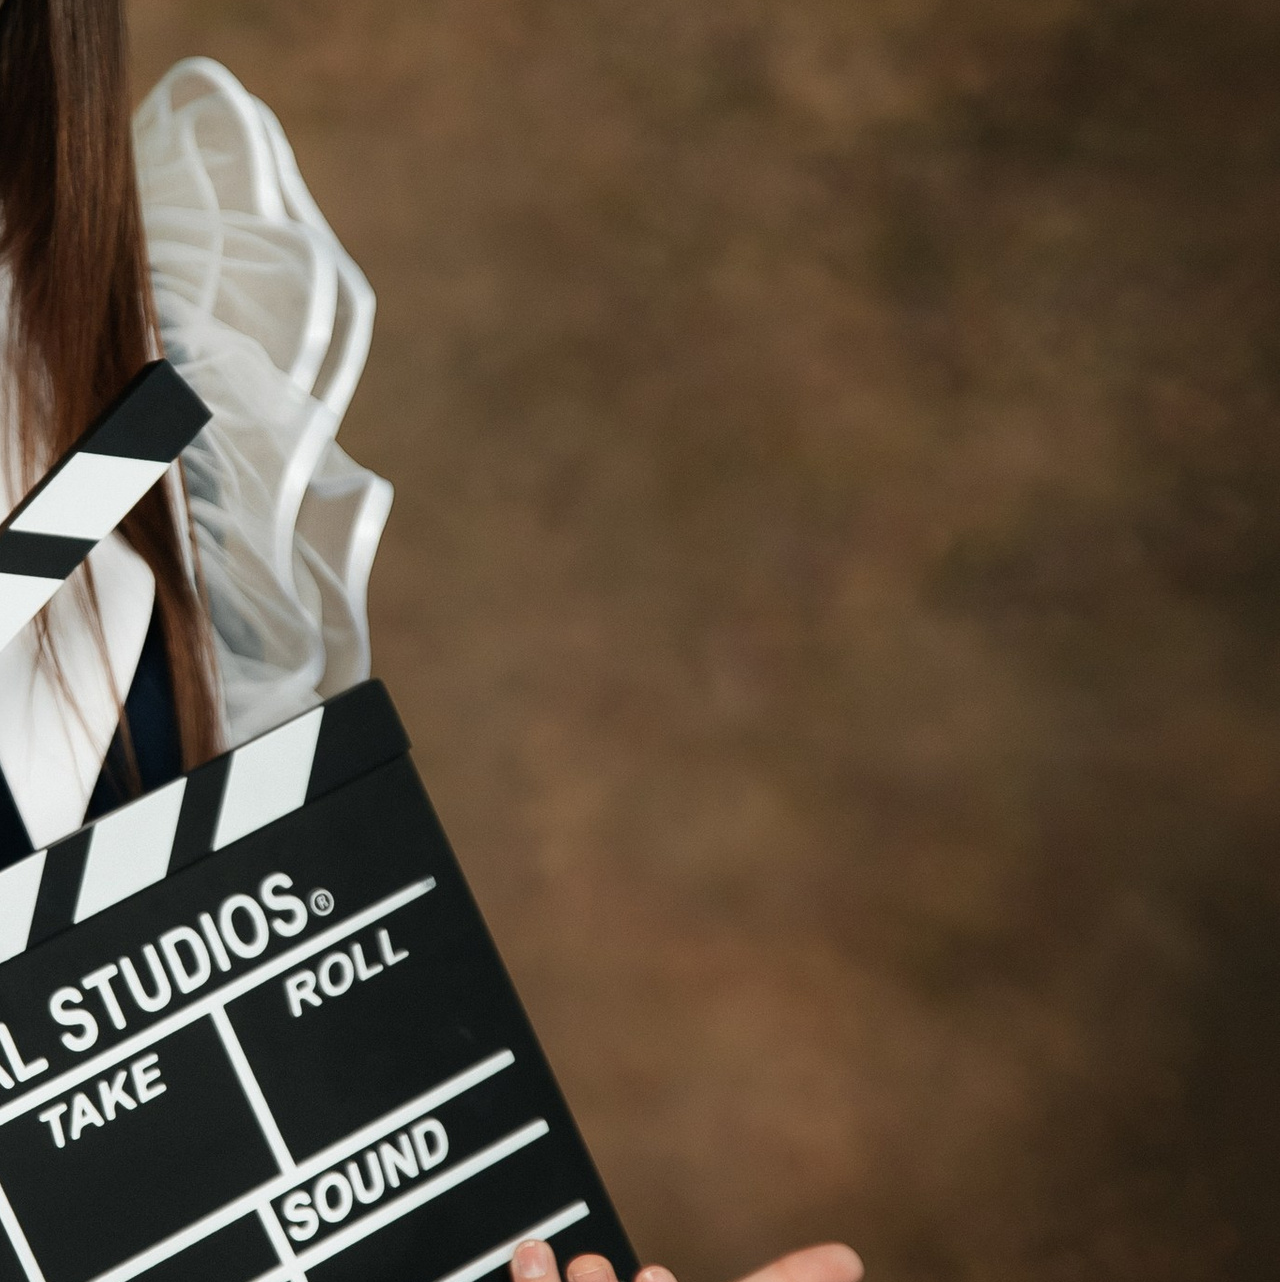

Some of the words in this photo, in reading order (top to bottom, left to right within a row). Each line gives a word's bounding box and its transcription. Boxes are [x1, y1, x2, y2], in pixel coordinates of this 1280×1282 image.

[284, 928, 410, 1018] ROLL
[38, 1053, 168, 1149] TAKE
[282, 1118, 449, 1242] SOUND
